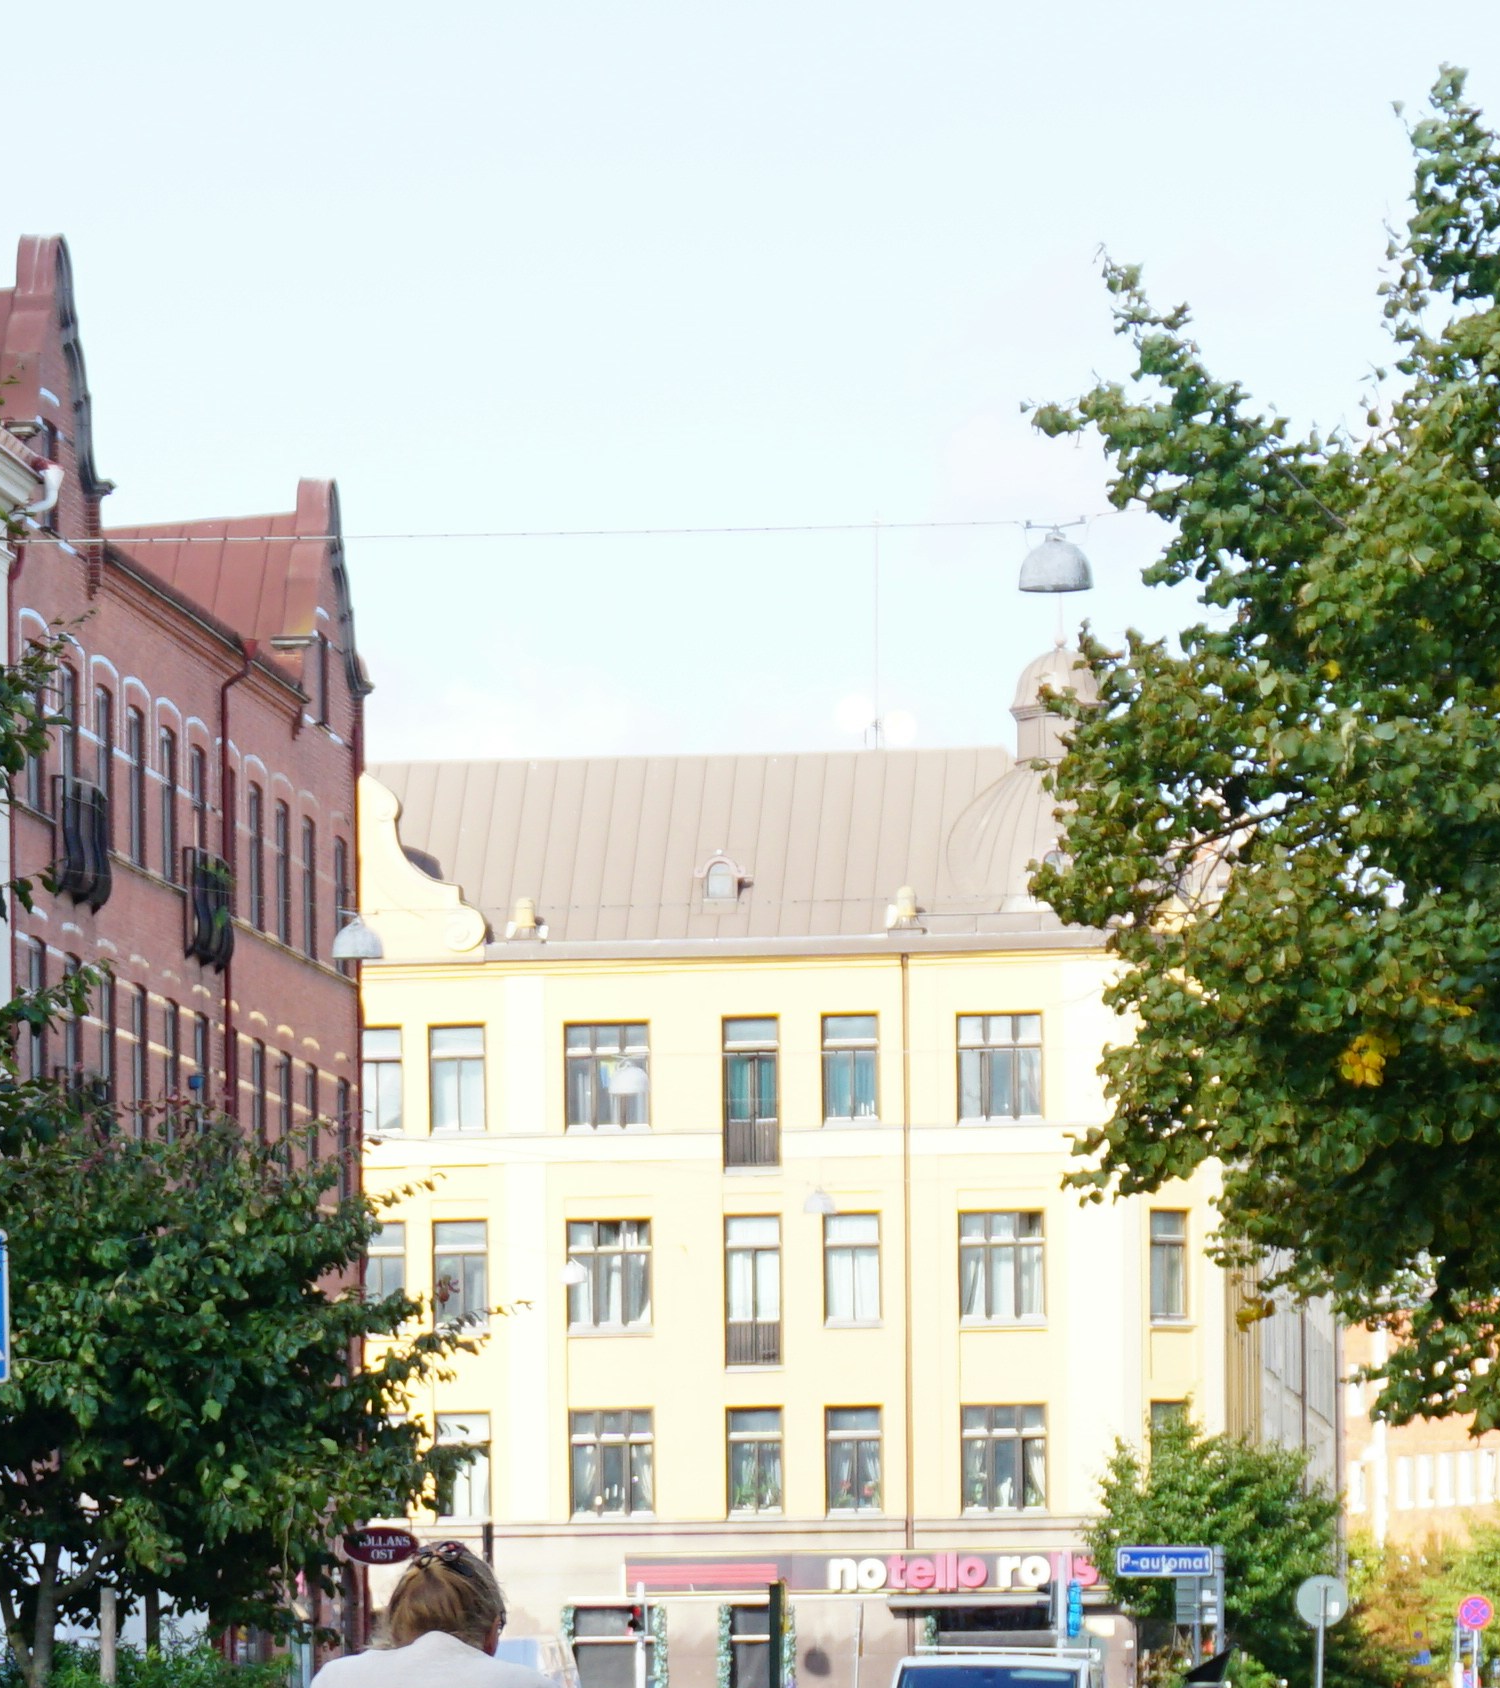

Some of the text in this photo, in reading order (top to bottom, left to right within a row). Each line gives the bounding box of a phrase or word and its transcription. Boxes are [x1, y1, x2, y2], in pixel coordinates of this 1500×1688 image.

[359, 1534, 411, 1547] ÖLLANS
[371, 1548, 395, 1560] OST
[1121, 1553, 1210, 1570] P-automat
[828, 1550, 988, 1591] notello
